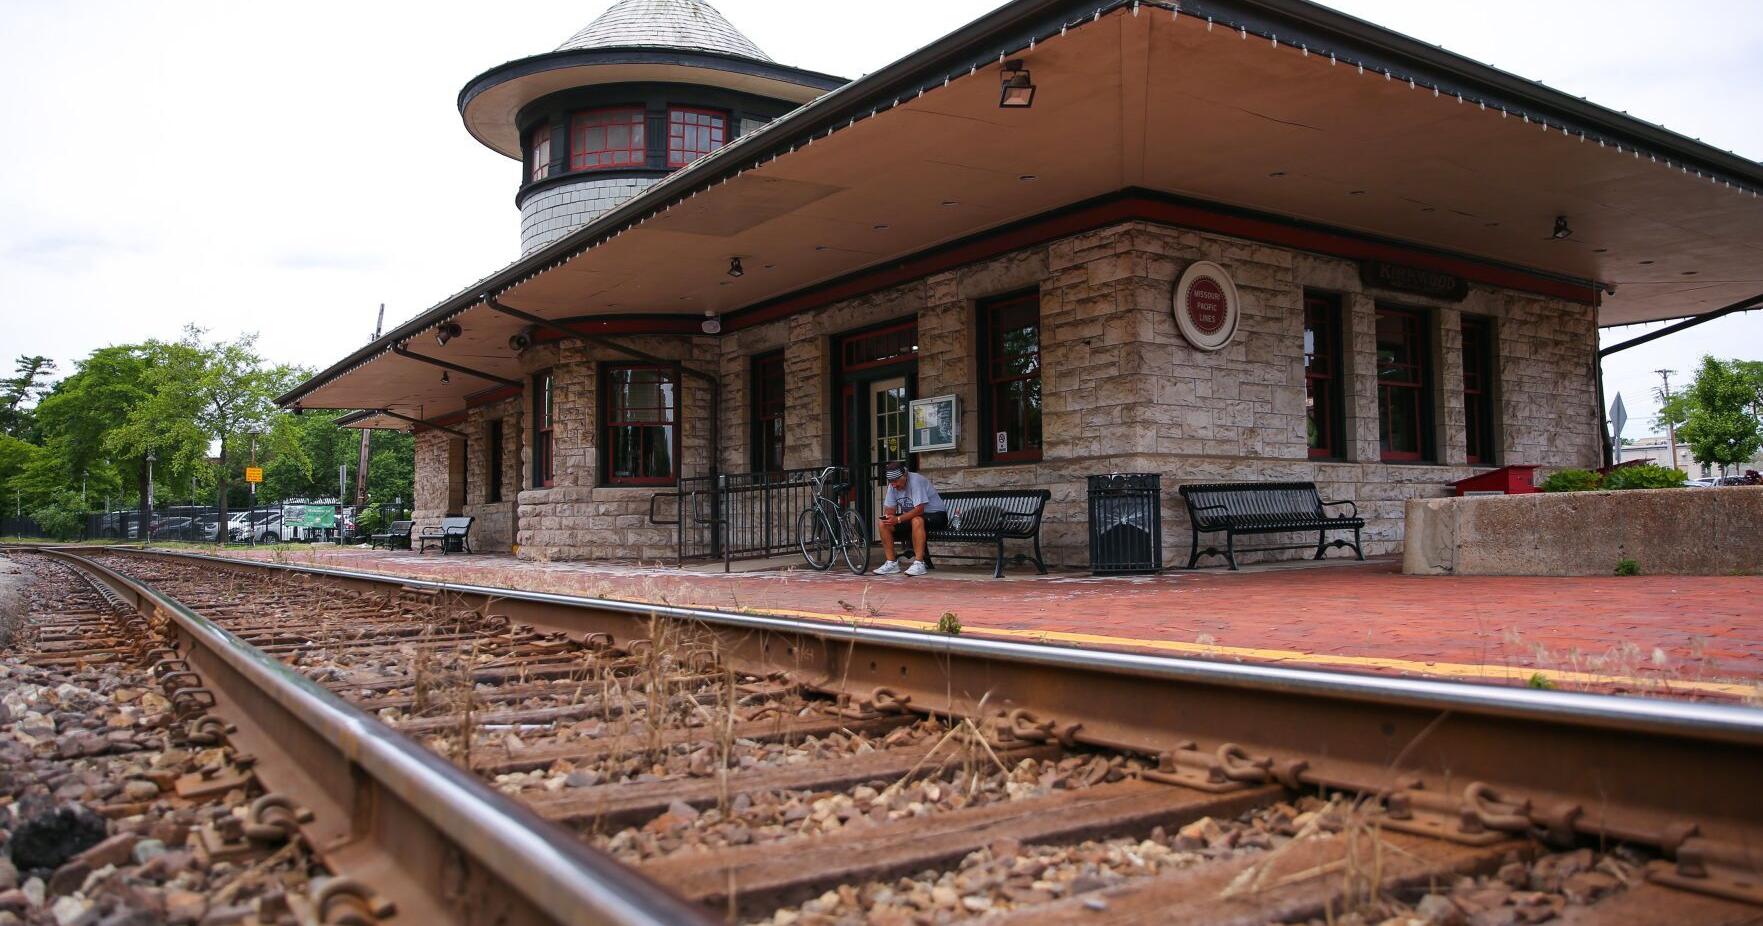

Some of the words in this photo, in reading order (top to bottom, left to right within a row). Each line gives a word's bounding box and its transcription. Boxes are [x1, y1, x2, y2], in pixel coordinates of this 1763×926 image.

[1193, 289, 1220, 300] MISSOURI
[1197, 301, 1217, 312] PACIFIC
[1200, 313, 1217, 323] LINES
